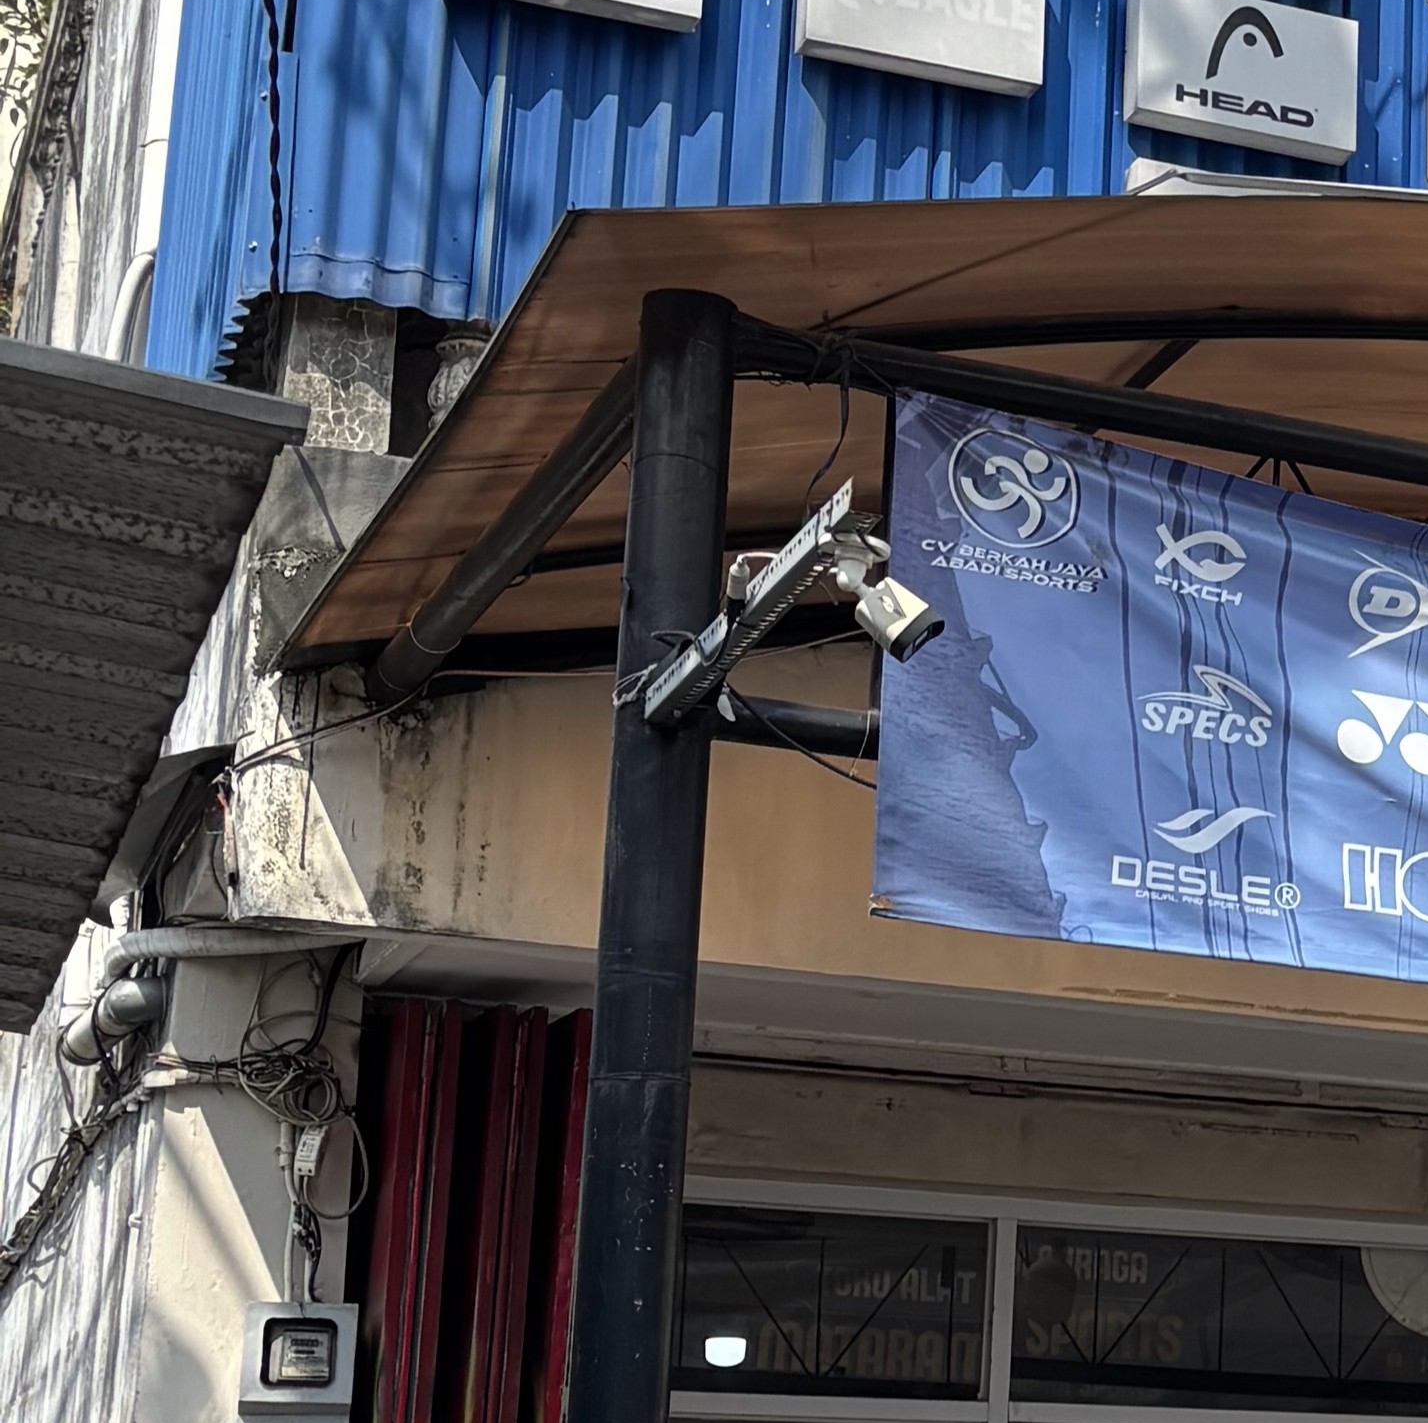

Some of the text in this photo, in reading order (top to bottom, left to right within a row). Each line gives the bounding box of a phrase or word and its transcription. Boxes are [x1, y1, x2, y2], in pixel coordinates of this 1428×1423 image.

[1176, 84, 1315, 128] HEAD
[921, 538, 954, 553] CV
[959, 544, 1046, 571] BERKAH
[1003, 566, 1097, 592] SPORTS
[1141, 702, 1272, 747] SPECS
